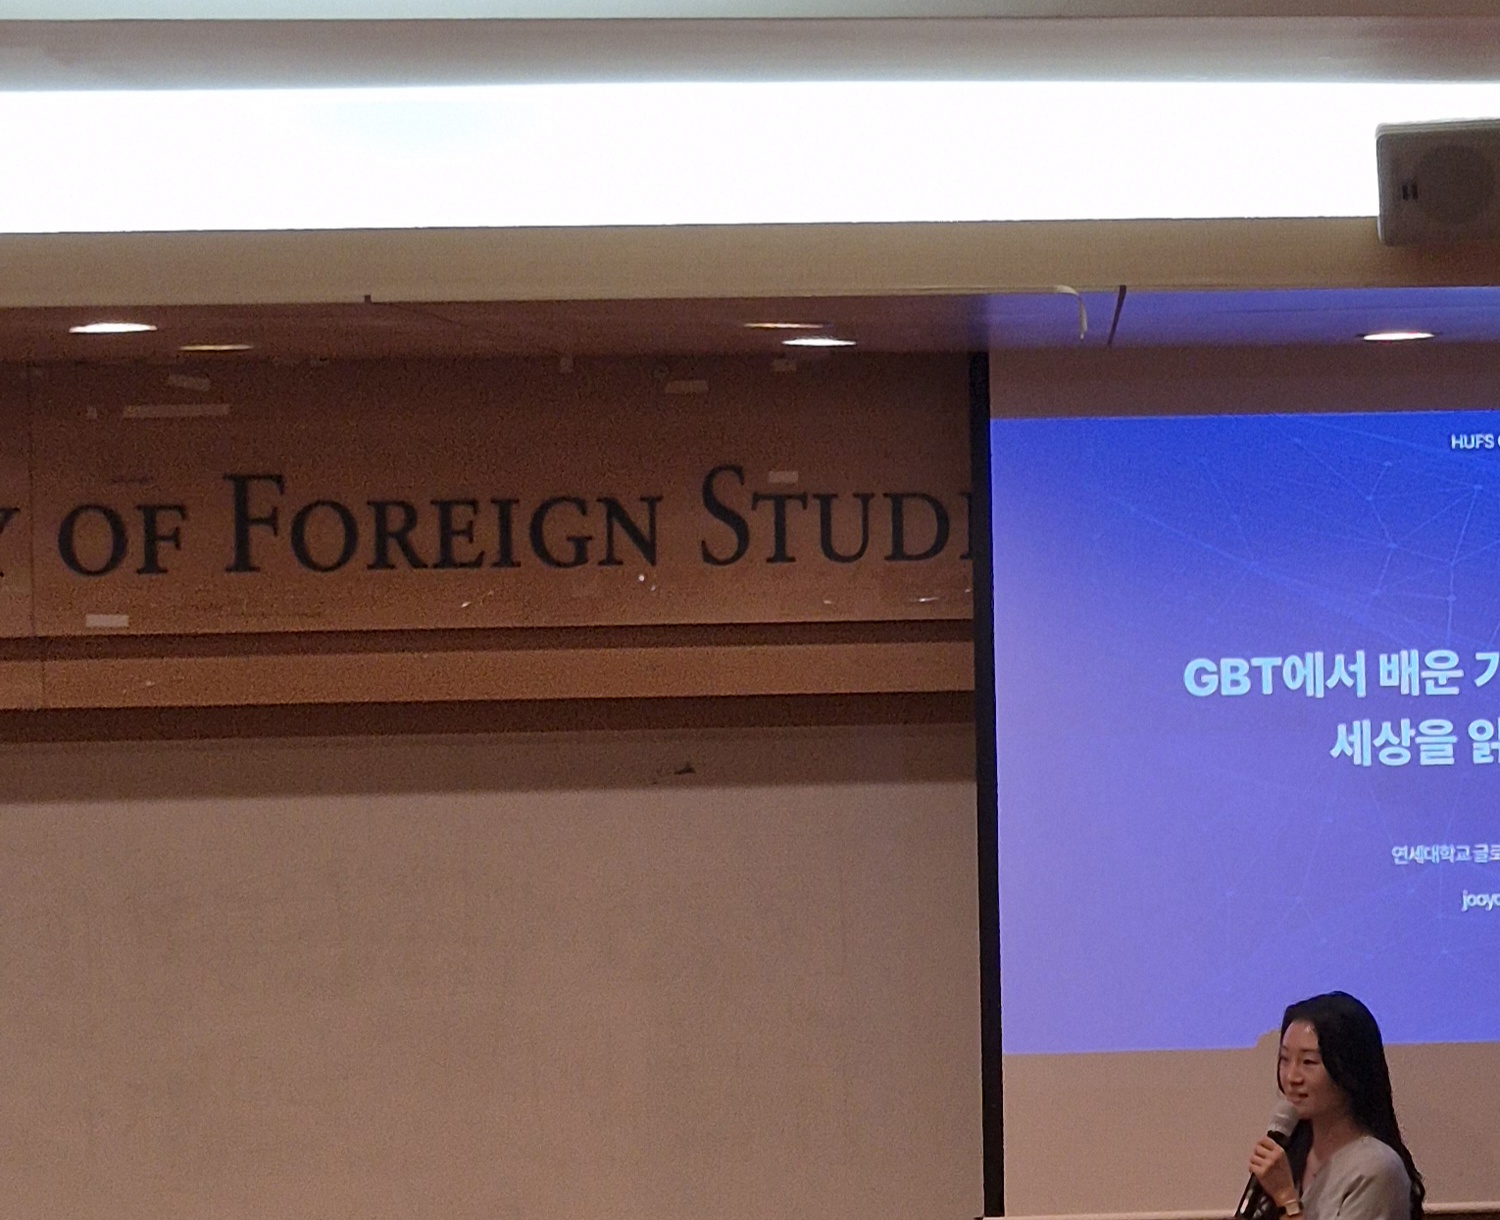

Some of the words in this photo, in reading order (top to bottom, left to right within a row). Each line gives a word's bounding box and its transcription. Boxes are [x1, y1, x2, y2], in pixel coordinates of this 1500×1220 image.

[1451, 433, 1494, 450] HUFS
[58, 504, 188, 577] OF
[223, 473, 663, 573] FOREIGN
[1183, 650, 1367, 698] GBT에서
[1379, 649, 1464, 696] 배운
[1330, 718, 1458, 767] 세상을
[1391, 843, 1471, 865] 연세대학교
